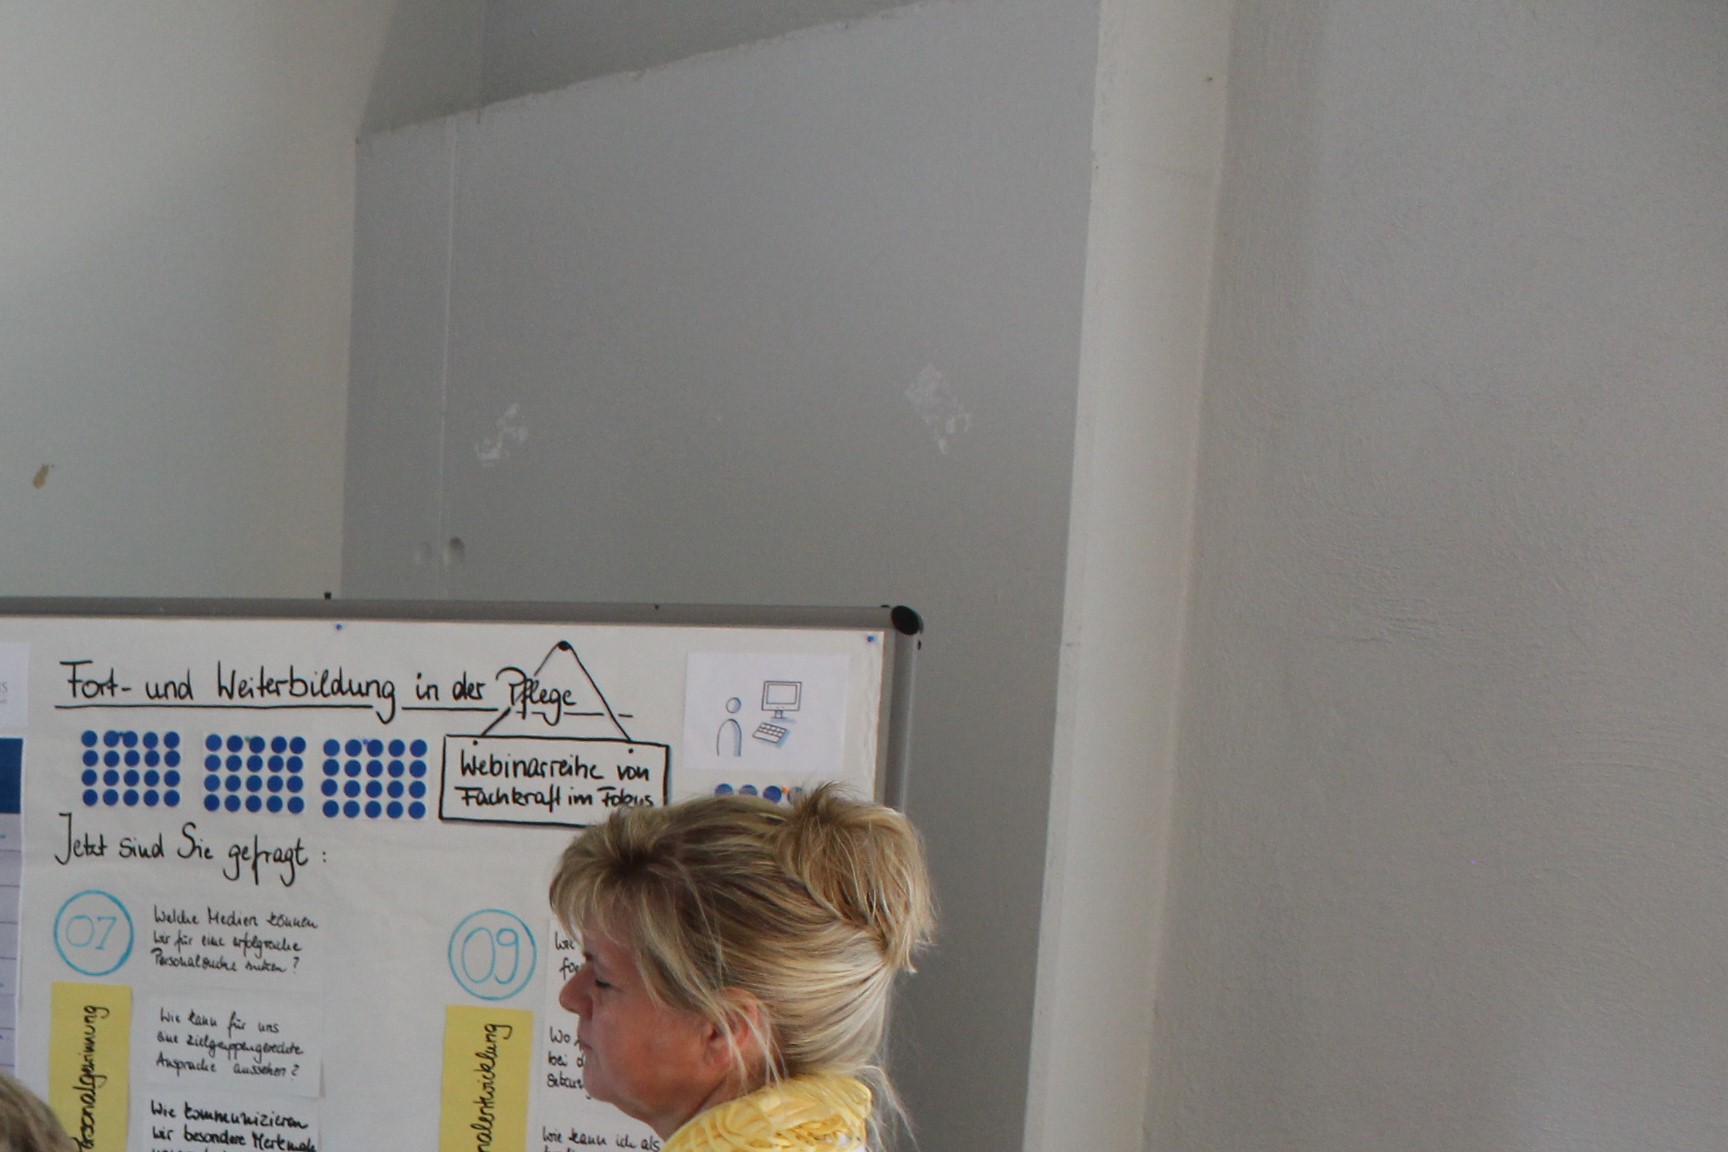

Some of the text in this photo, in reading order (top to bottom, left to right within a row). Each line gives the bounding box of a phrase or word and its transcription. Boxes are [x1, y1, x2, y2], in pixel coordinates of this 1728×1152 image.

[59, 660, 578, 727] Fort- und Weiterbildung in der Pflege
[459, 750, 651, 783] Webinarreihe von
[455, 780, 654, 810] Fachkraft im Fokus
[53, 812, 108, 865] Jetzt
[118, 829, 164, 861] sind
[176, 821, 214, 862] Sie
[153, 904, 320, 930] Welche Medien können
[66, 914, 118, 951] 07
[174, 930, 193, 953] für
[201, 932, 225, 947] eine
[233, 931, 303, 960] erfolgreiche
[461, 926, 519, 984] 09
[156, 1030, 179, 1045] eine
[160, 1006, 281, 1039] Wie kann für uns
[549, 1025, 571, 1044] Wo
[156, 1050, 218, 1078] Ansprache
[150, 1099, 310, 1131] Wie kommunizieren
[183, 1124, 247, 1146] besondere
[251, 1130, 317, 1152] Merkmale
[568, 1127, 608, 1146] kann
[616, 1133, 637, 1149] ich
[640, 1135, 661, 1152] als
